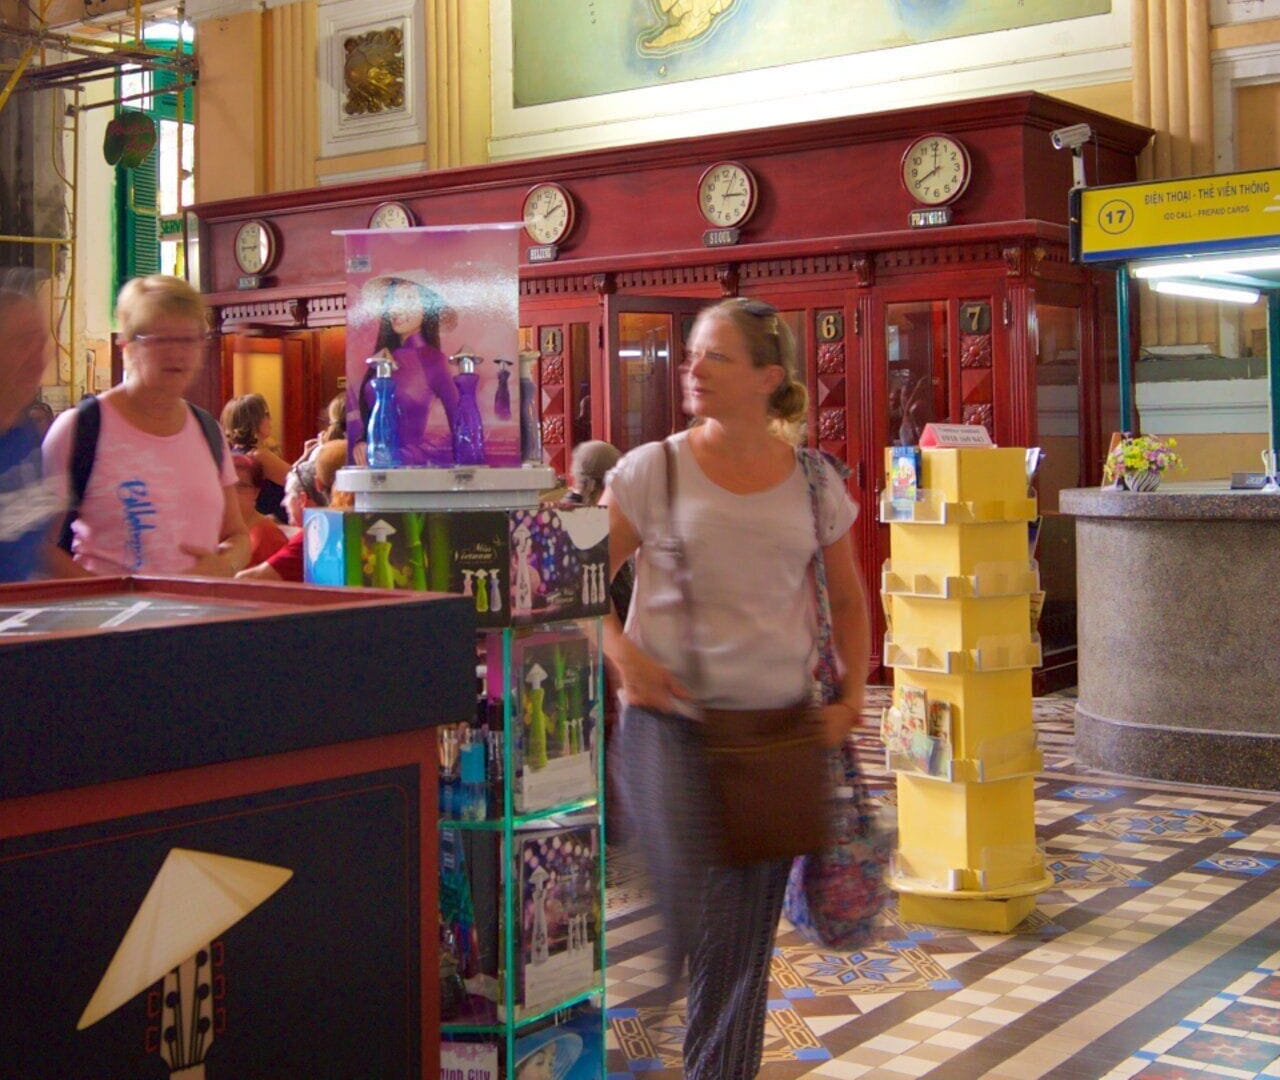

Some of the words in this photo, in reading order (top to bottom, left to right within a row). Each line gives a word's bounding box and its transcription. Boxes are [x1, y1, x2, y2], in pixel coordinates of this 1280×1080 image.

[1105, 209, 1127, 225] 17
[822, 315, 836, 340] 6
[966, 306, 981, 331] 7
[543, 330, 557, 352] 4
